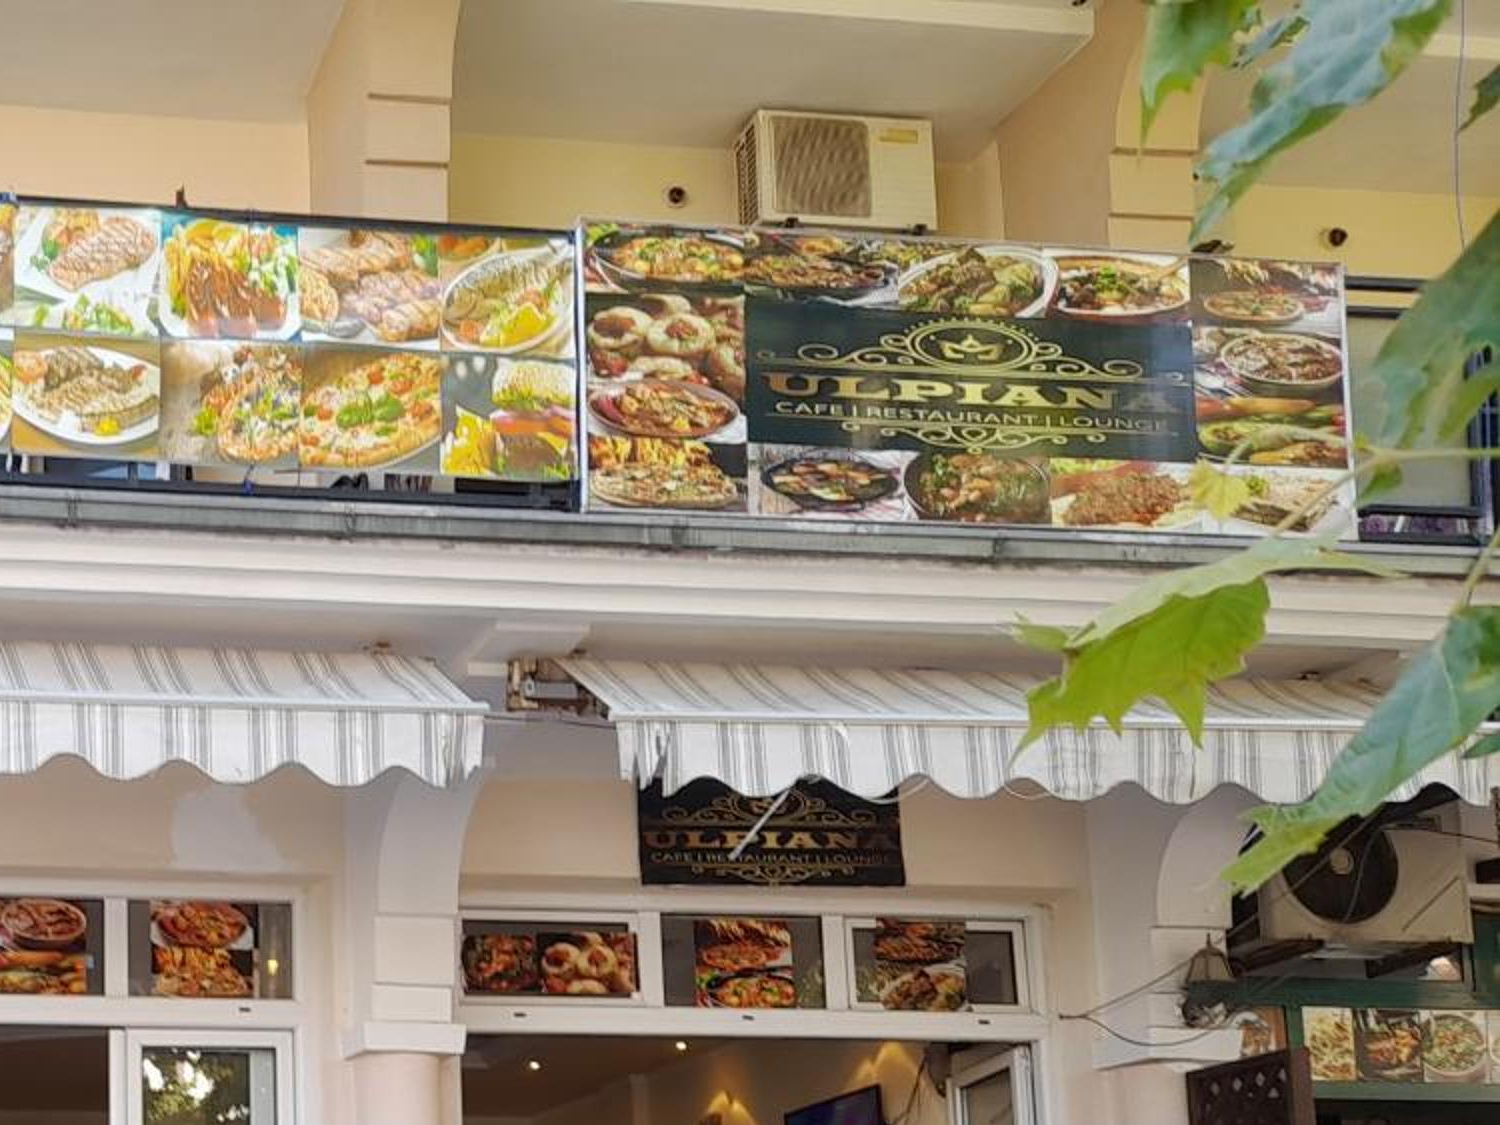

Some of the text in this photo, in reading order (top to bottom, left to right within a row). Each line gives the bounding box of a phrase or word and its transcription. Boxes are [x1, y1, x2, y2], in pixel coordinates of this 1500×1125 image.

[762, 371, 1185, 413] ULPIANA
[775, 400, 842, 416] CAFE
[867, 406, 1038, 426] RESTAURANT
[1060, 415, 1168, 432] LOUNGE
